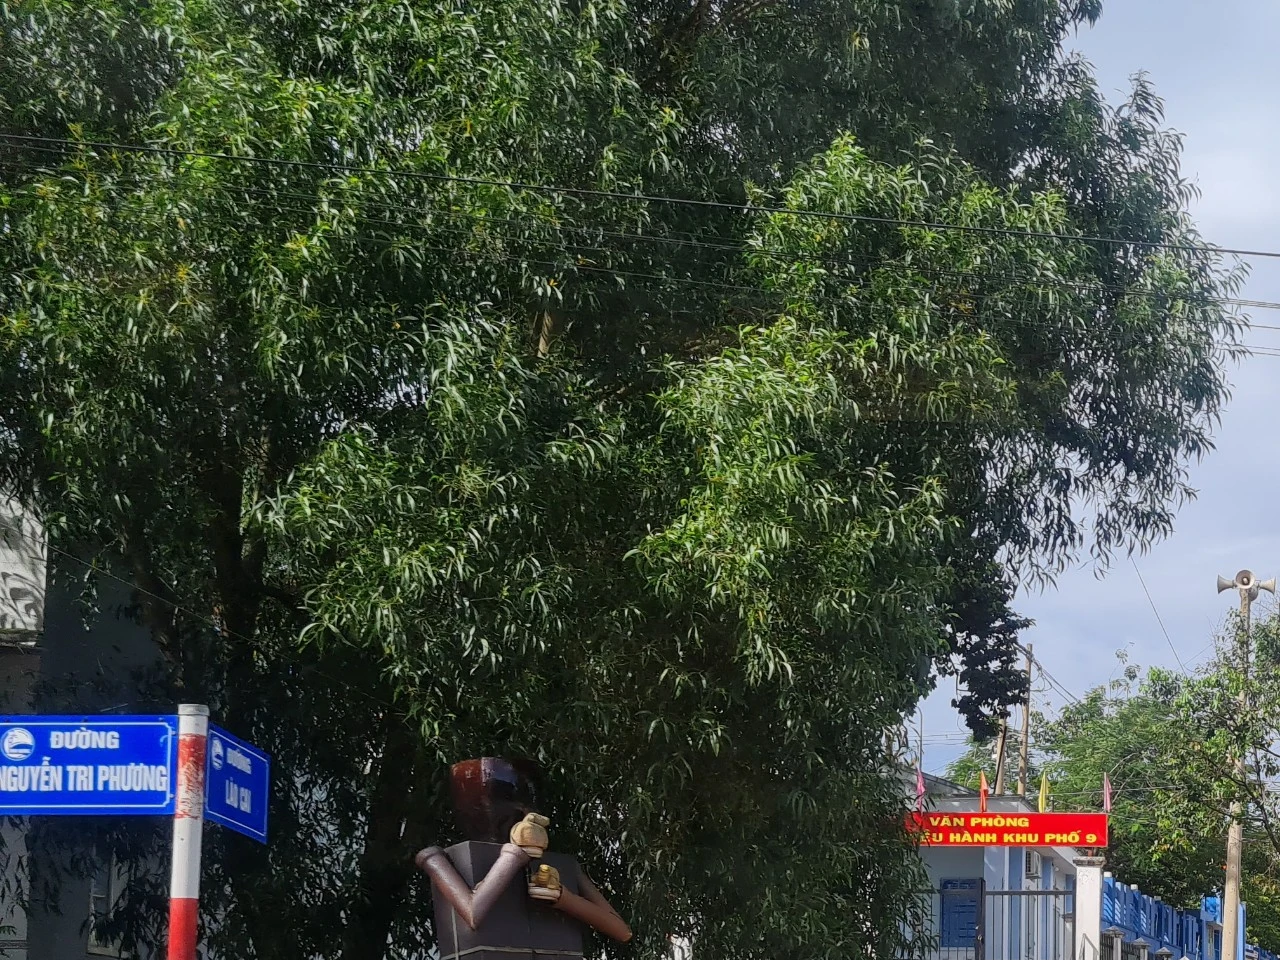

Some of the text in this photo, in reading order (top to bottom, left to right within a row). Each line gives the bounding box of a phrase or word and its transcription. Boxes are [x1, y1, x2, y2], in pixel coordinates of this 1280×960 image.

[50, 727, 120, 750] ĐƯỜNG
[0, 756, 168, 792] NGUYỄN TRI PHƯƠNG
[929, 815, 1030, 828] VĂN PHÒNG
[949, 830, 997, 843] HÀNH
[1003, 833, 1039, 843] KHU
[1044, 829, 1082, 843] PHỐ
[1085, 833, 1097, 843] 9
